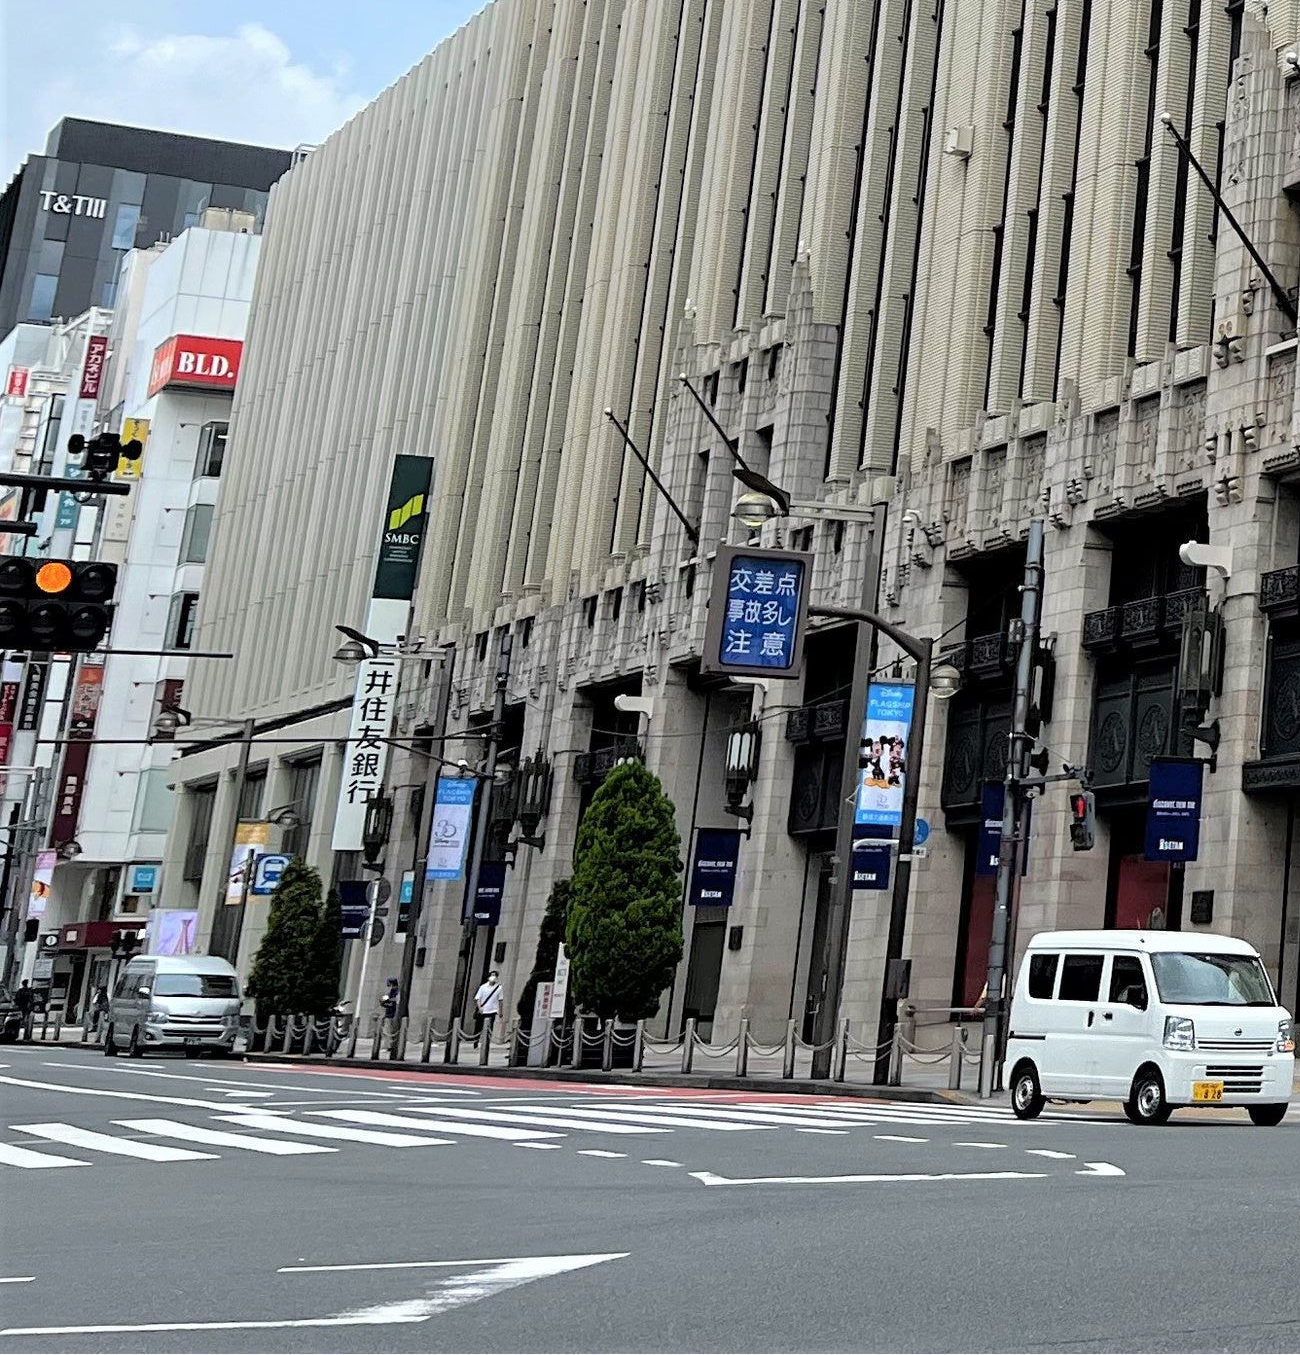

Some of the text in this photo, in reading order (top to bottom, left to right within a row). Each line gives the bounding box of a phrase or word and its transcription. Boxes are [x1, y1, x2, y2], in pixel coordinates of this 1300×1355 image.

[177, 351, 234, 379] BLD.
[384, 532, 420, 545] SMBC
[729, 567, 797, 597] 交差点
[727, 598, 792, 626] 事故多し
[725, 628, 786, 656] 注意
[347, 643, 396, 804] 三井住友銀行
